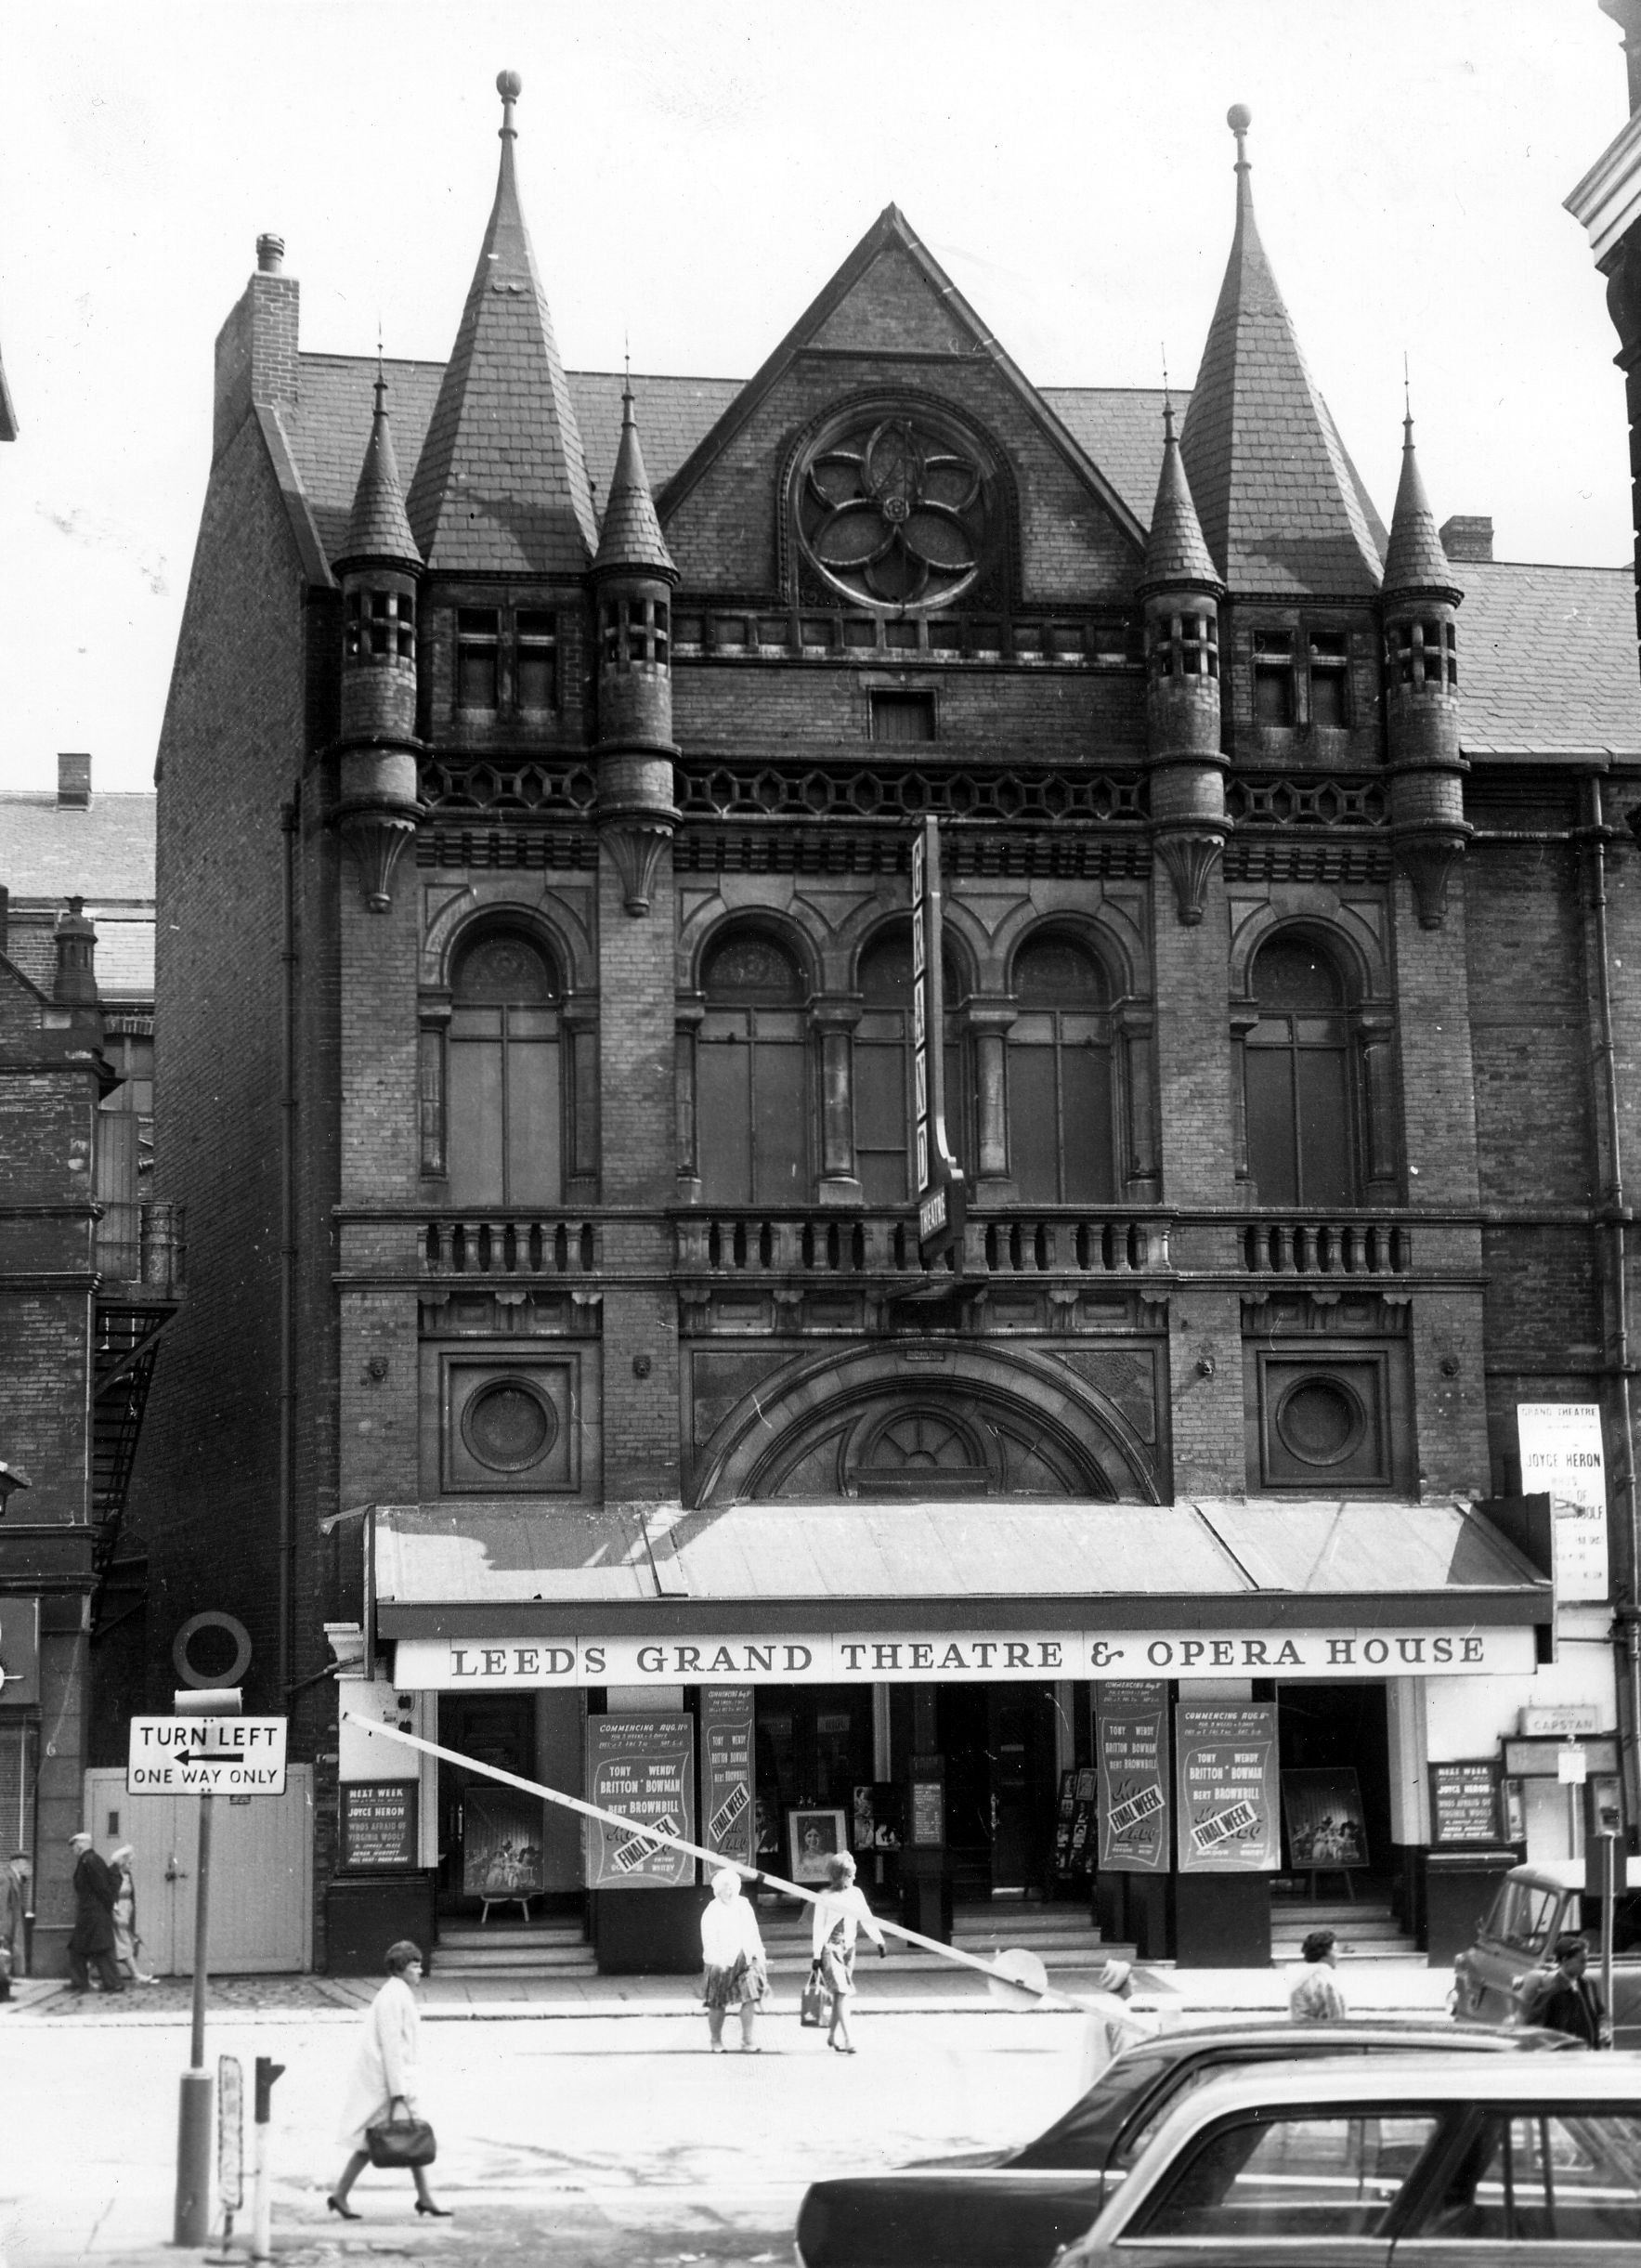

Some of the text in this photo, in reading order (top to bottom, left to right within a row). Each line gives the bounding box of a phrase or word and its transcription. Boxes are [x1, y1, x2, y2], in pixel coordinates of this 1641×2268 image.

[1526, 1453, 1601, 1467] JOYCE HERON
[451, 1638, 1483, 1675] LEEDS GRAND THEATRE & OPERA HOUSE
[1534, 1720, 1592, 1729] CAPSTAN
[140, 1727, 277, 1746] TURN LEFT
[1197, 1753, 1259, 1763] TONY WENDY
[135, 1769, 278, 1783] ONE WAY ONLY
[609, 1766, 676, 1777] TONY WENDY
[1190, 1766, 1262, 1779] BRITTON BOWMAN
[349, 1788, 403, 1798] NEXT WEEK
[601, 1779, 680, 1793] BRITTON BOWMAN
[1193, 1787, 1259, 1800] BERT BROWNBILL
[348, 1806, 405, 1817] JOYCE HERON
[608, 1801, 679, 1814] BERT BROWNBILL
[711, 1786, 748, 1839] FINAL WEEK
[1111, 1803, 1137, 1831] FINAL
[1132, 1788, 1162, 1818] WEEK
[1194, 1820, 1225, 1847] FINAL
[1219, 1804, 1254, 1832] WEEK
[618, 1839, 649, 1870] FINAL
